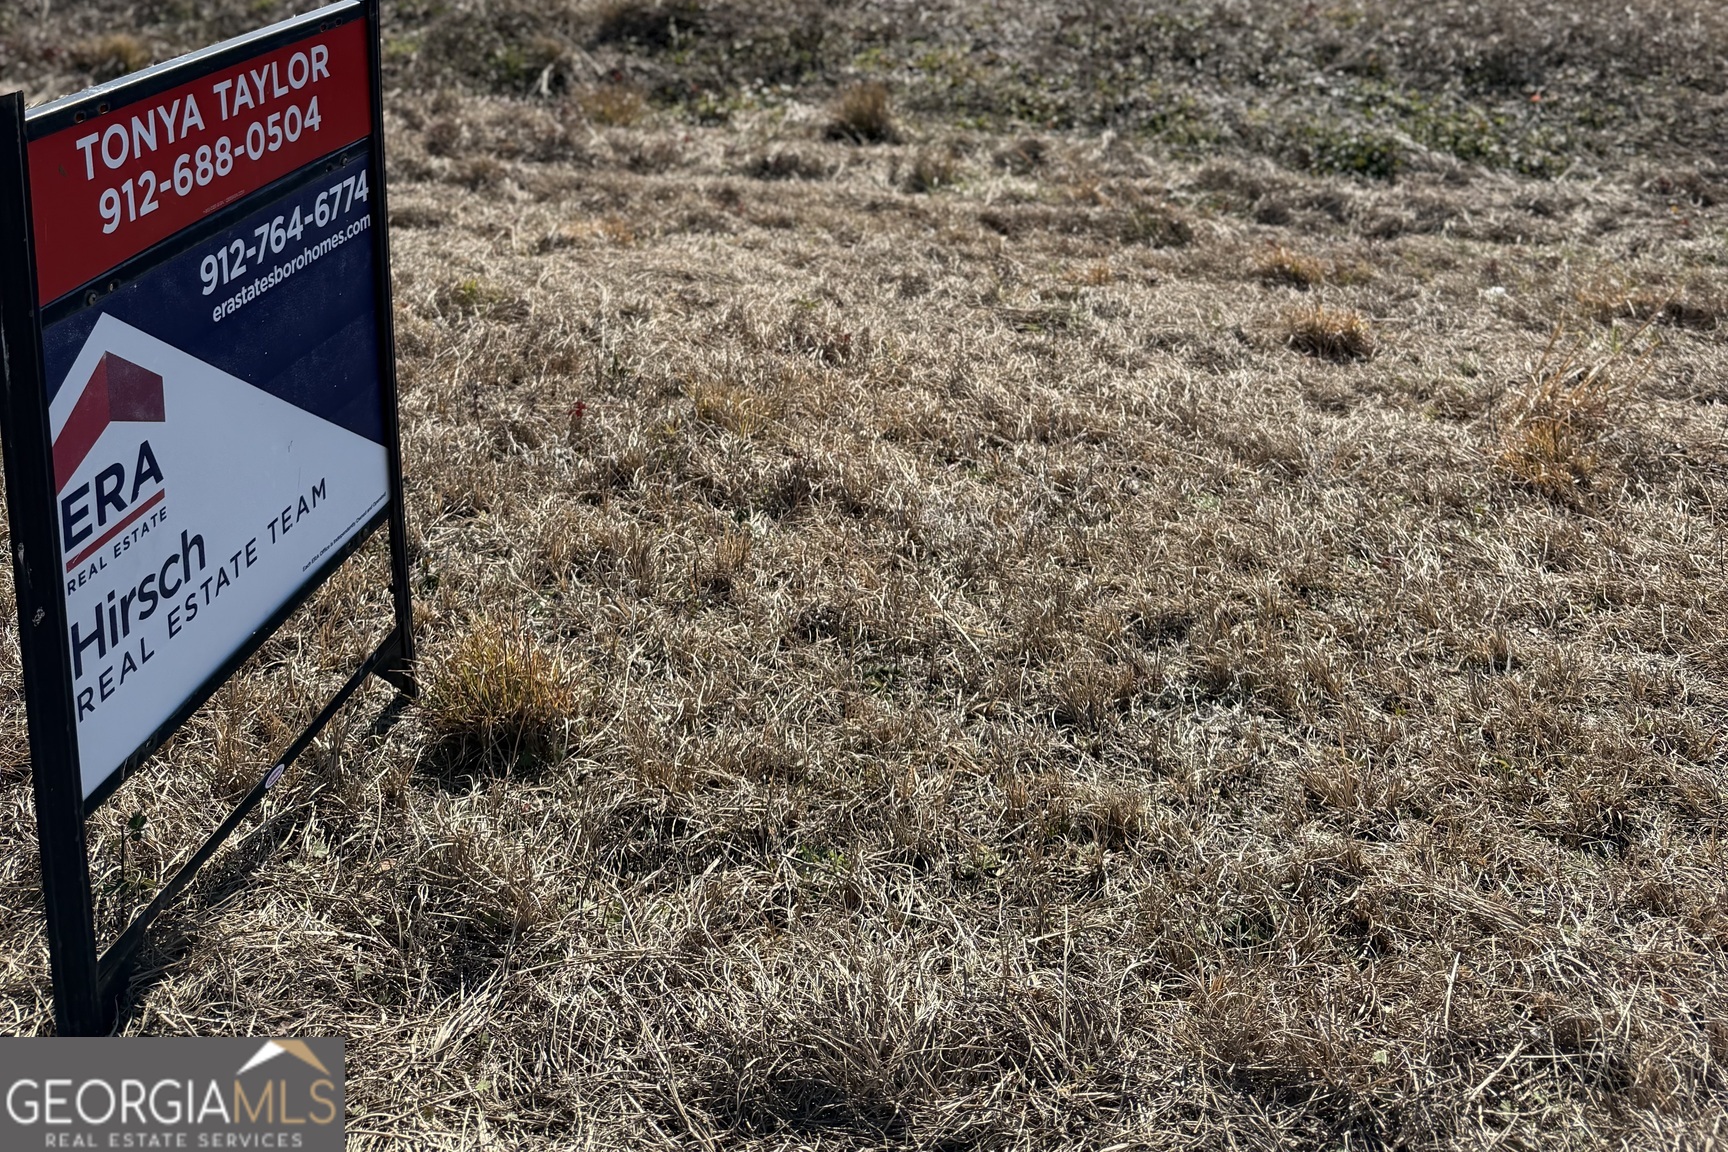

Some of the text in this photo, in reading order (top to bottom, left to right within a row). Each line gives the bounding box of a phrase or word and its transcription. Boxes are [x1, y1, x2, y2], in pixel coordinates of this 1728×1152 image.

[76, 44, 331, 181] TONYA TAYLOR
[99, 96, 322, 234] 912-688-0504
[199, 169, 369, 296] 912-764-6774
[212, 214, 371, 323] erastatesborohomes.com
[61, 440, 164, 554] ERA
[67, 506, 167, 596] REAL ESTATE
[71, 529, 206, 681] Hirsch
[76, 477, 326, 723] REAL ESTATE TEAM
